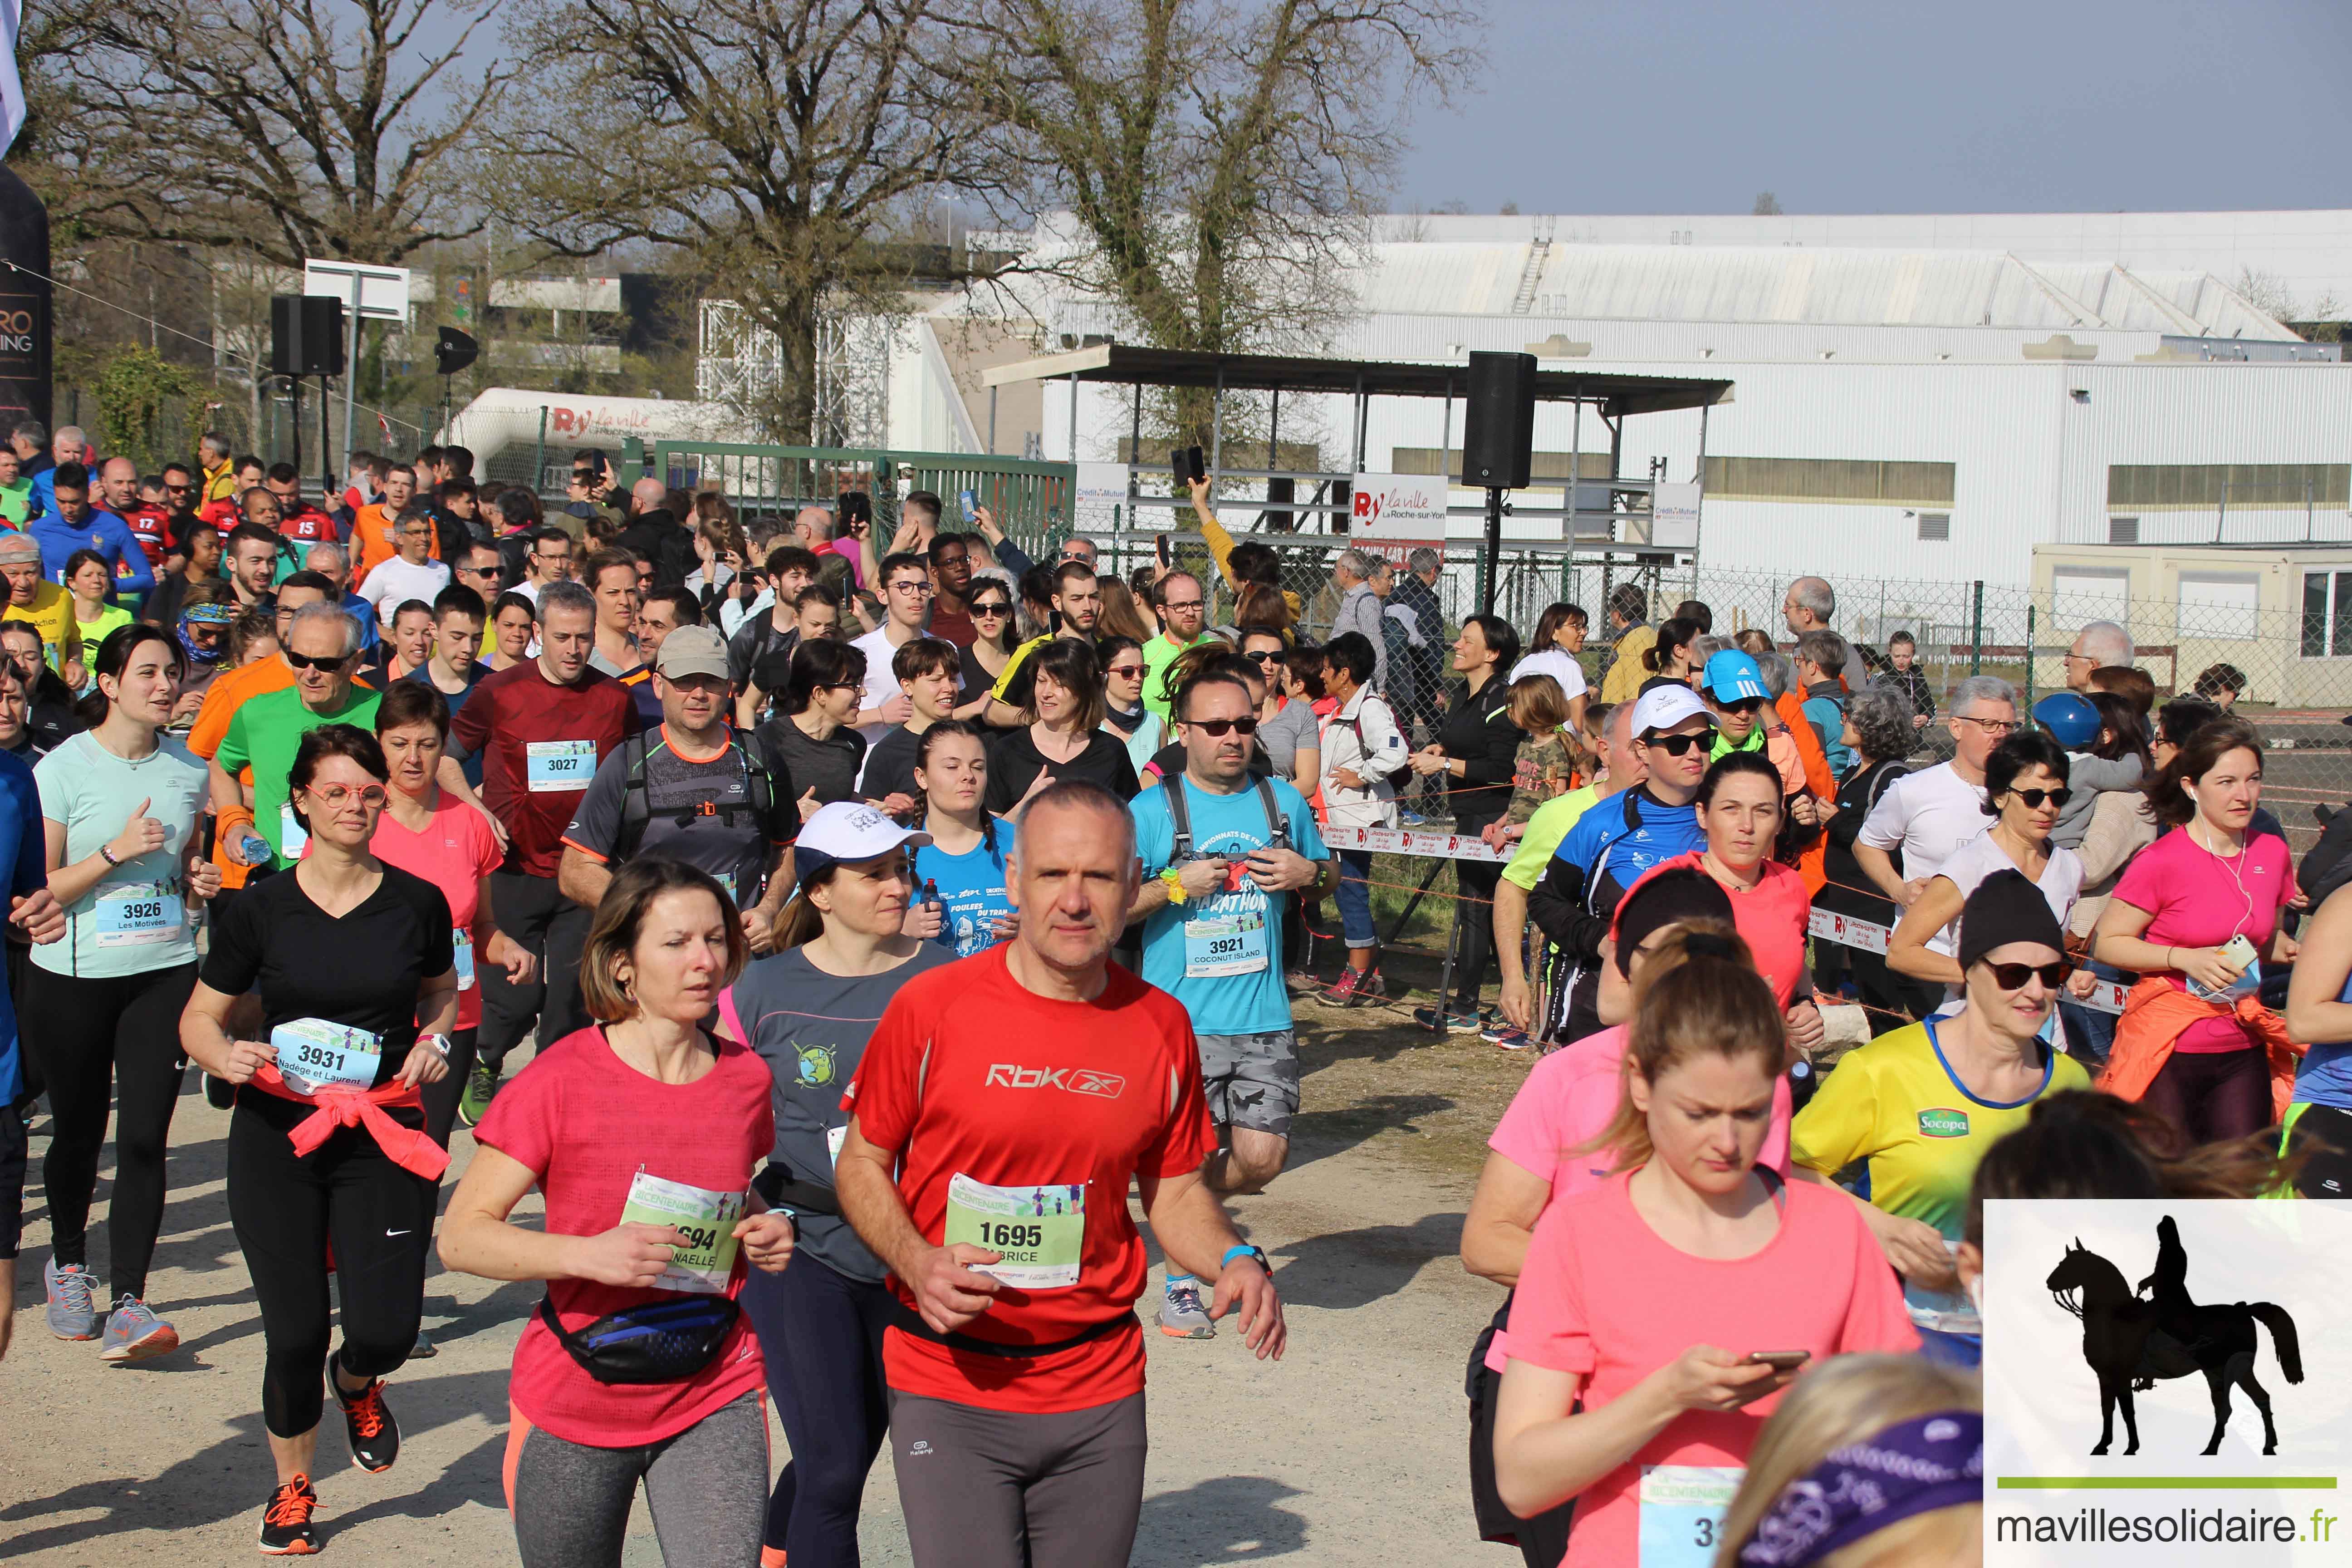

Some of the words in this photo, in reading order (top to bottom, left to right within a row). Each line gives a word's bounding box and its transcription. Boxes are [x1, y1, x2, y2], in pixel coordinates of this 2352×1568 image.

[1103, 490, 1125, 498] Mutuel
[1354, 492, 1384, 526] Ry
[1404, 490, 1428, 508] ville
[139, 518, 155, 529] 17
[298, 522, 315, 534] 15
[548, 759, 578, 770] 3027
[123, 902, 161, 919] 3926
[951, 902, 984, 913] FOULEES
[135, 919, 166, 928] Motivées
[1210, 936, 1244, 954] 3921
[1195, 954, 1233, 963] COCONUT
[1234, 950, 1260, 959] ISLAND
[298, 1044, 345, 1071] 3931
[279, 1058, 311, 1075] Nadège
[314, 1071, 323, 1079] et
[324, 1073, 361, 1085] Laurent
[1921, 1116, 1967, 1132] Socopa
[635, 1191, 699, 1213] BICENTENAIRE
[952, 1188, 1010, 1211] BICENTENAIRE
[980, 1221, 1042, 1247] 1695
